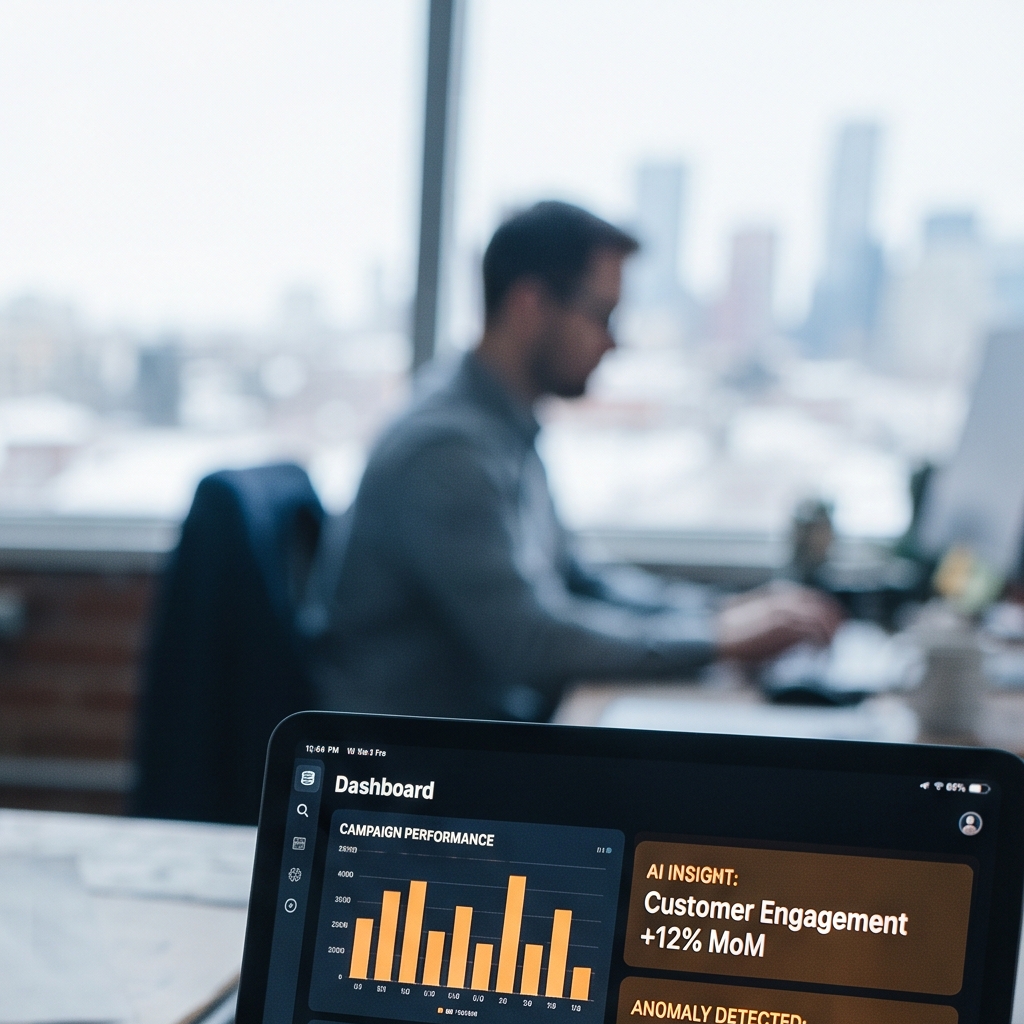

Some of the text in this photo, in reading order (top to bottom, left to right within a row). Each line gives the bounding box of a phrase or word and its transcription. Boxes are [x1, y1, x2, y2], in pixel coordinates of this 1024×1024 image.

[335, 775, 435, 800] Dashboard
[339, 822, 495, 847] CAMPAIGN PERFORMANCE
[646, 863, 739, 887] AI INSIGHT:
[644, 890, 909, 936] Customer Engagement
[640, 925, 766, 958] +12% MoM
[630, 999, 712, 1023] ANOMALY
